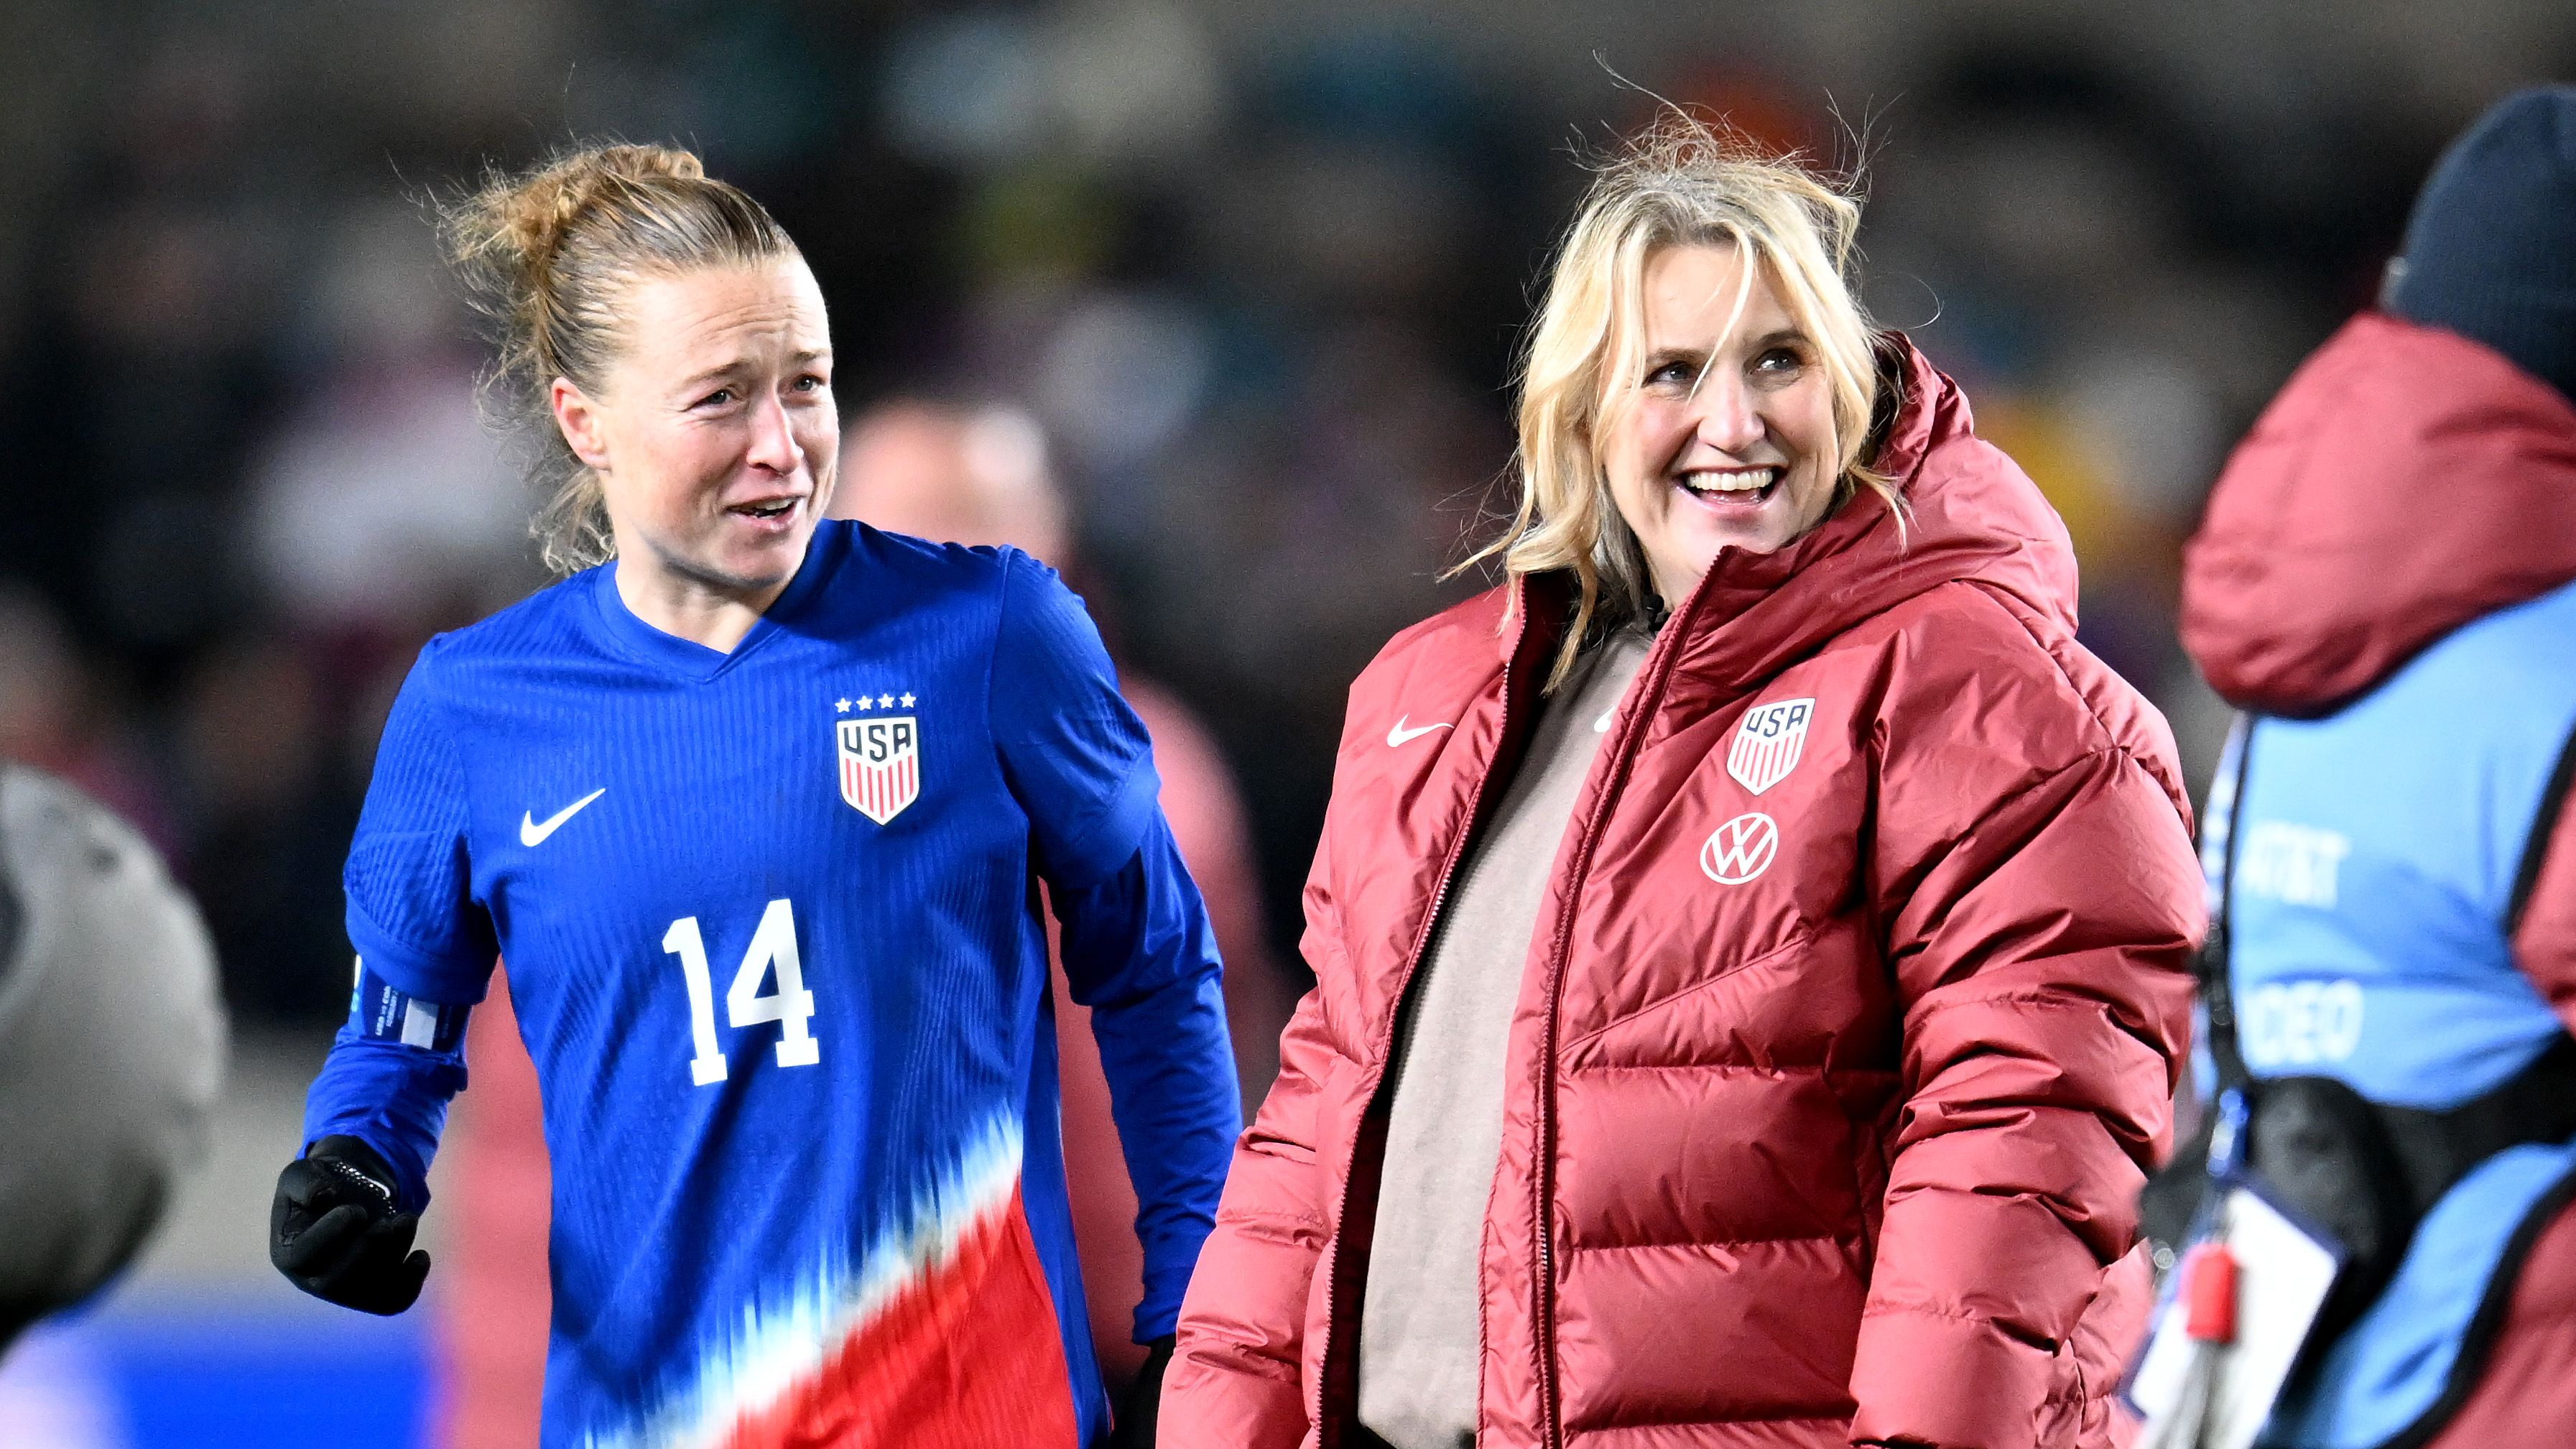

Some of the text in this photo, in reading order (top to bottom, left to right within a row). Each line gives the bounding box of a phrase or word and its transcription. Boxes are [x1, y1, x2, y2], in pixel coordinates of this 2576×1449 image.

[1746, 705, 1807, 738] USA
[843, 723, 912, 762] USA
[662, 898, 820, 1086] 14
